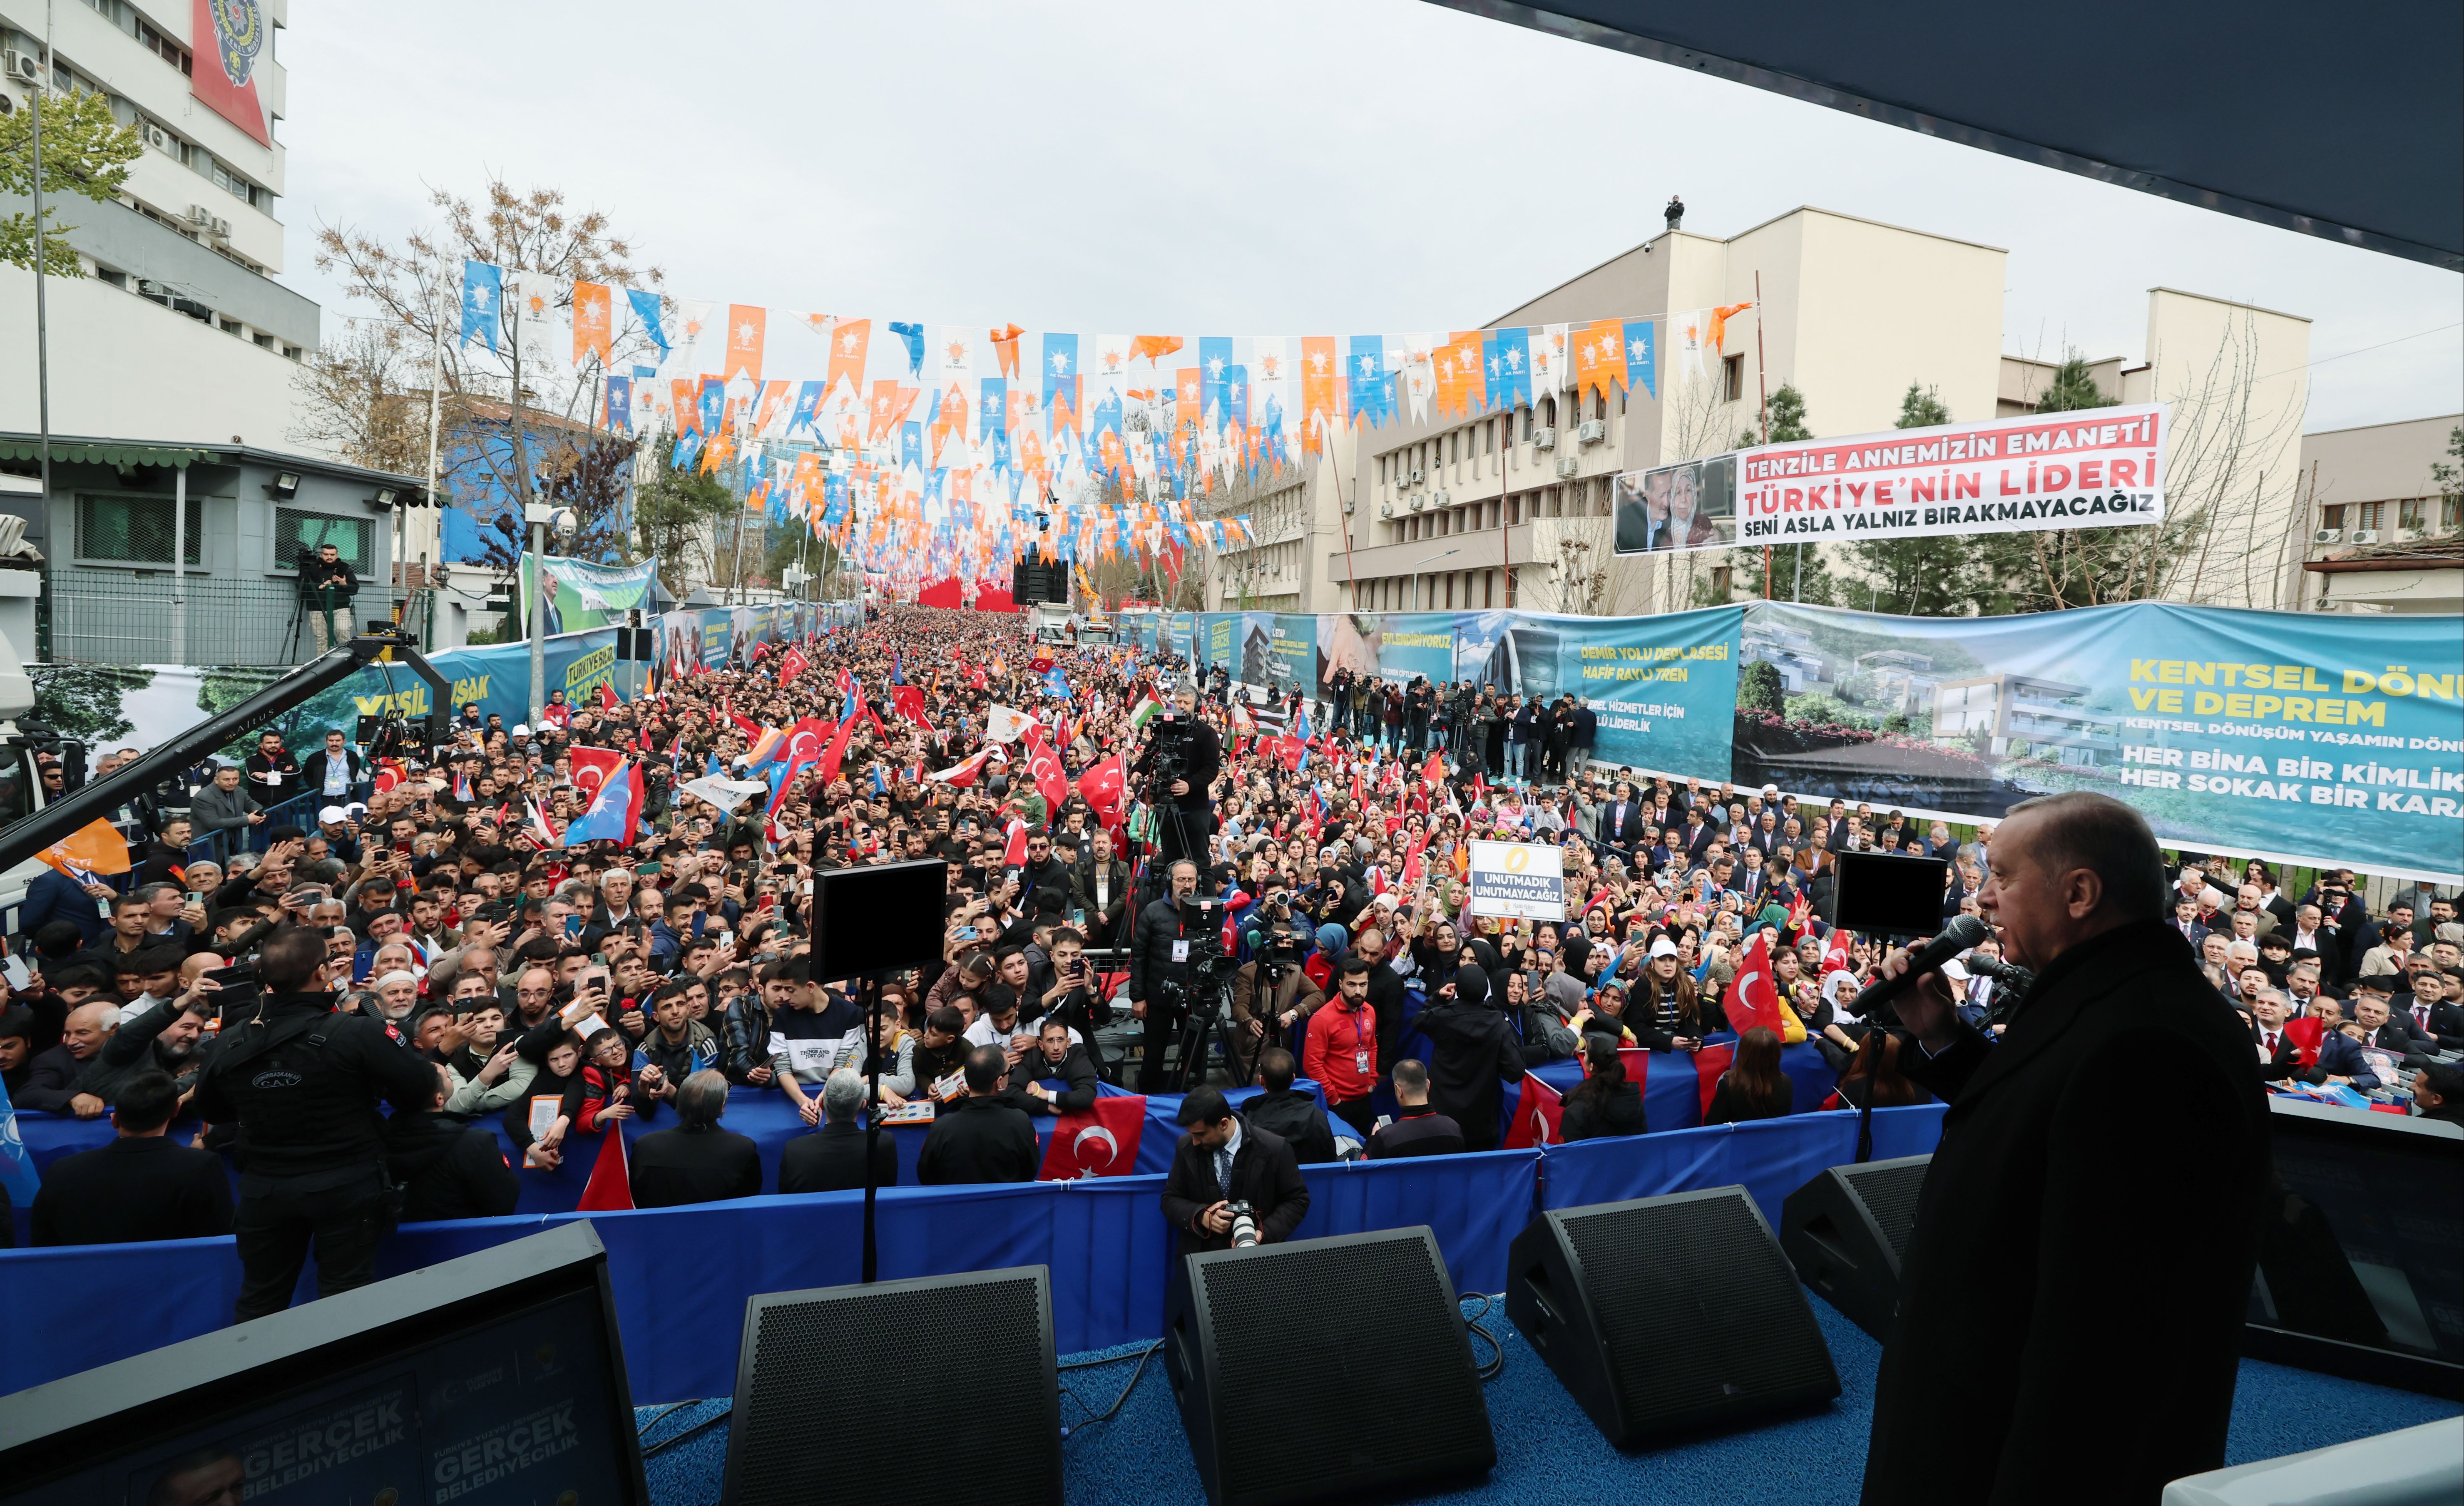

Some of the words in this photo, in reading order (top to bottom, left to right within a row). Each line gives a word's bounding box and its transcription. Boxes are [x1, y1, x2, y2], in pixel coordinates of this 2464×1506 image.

[1748, 450, 1837, 481] TENZİLE
[1845, 433, 1997, 471] ANNEMİZİN
[2006, 414, 2151, 455] EMANETİ
[2000, 451, 2155, 496] LİDERİ
[1744, 514, 1778, 537] SENİ
[1784, 514, 1832, 535] ASLA
[1843, 509, 1918, 530] YALNIZ
[1924, 490, 2154, 525] BIRAKMAYACAĞIZ
[1211, 632, 1230, 650] GERÇEK
[1276, 629, 1285, 638] ETAP
[1382, 631, 1452, 649] EVLENDİRİYORUZ
[1581, 644, 1617, 661] DEMİR
[1621, 647, 1652, 661] YOLU
[1653, 642, 1728, 661] DEPLASESİ
[569, 654, 598, 683] TÜRKİYE
[599, 646, 613, 666] BİLİR
[1381, 668, 1399, 676] EVLENEN
[1582, 664, 1615, 679] HAFİF
[1616, 667, 1653, 681] RAYLI
[1655, 668, 1688, 682] TREN
[2130, 659, 2330, 692] KENTSEL
[2342, 666, 2464, 700] DÖN
[236, 708, 274, 735] Altus
[1607, 700, 1661, 716] HİZMETLER
[1664, 703, 1685, 720] İÇİN
[2128, 687, 2183, 713] VE
[2194, 693, 2387, 727] DEPREM
[1609, 718, 1651, 733] LİDERLİK
[2125, 717, 2204, 735] KENTSEL
[2208, 721, 2305, 742] DÖNÜŞÜM
[2309, 730, 2404, 749] YAŞAMIN
[2409, 736, 2464, 753] DÖN
[2123, 745, 2183, 766] HER
[2190, 748, 2269, 775] BİNA
[2277, 755, 2333, 781] BİR
[2121, 767, 2180, 790] HER
[2187, 773, 2303, 803] SOKAK
[2310, 783, 2368, 809] BİR
[2377, 792, 2464, 819] KAR
[1476, 885, 1559, 902] UNUTMAYACAĞIZ
[1484, 873, 1551, 888] UNUTMADIK
[243, 1400, 403, 1479] GERÇEK
[434, 1407, 577, 1484] GERÇEK
[436, 1432, 579, 1505] BELEDİYECİLİK
